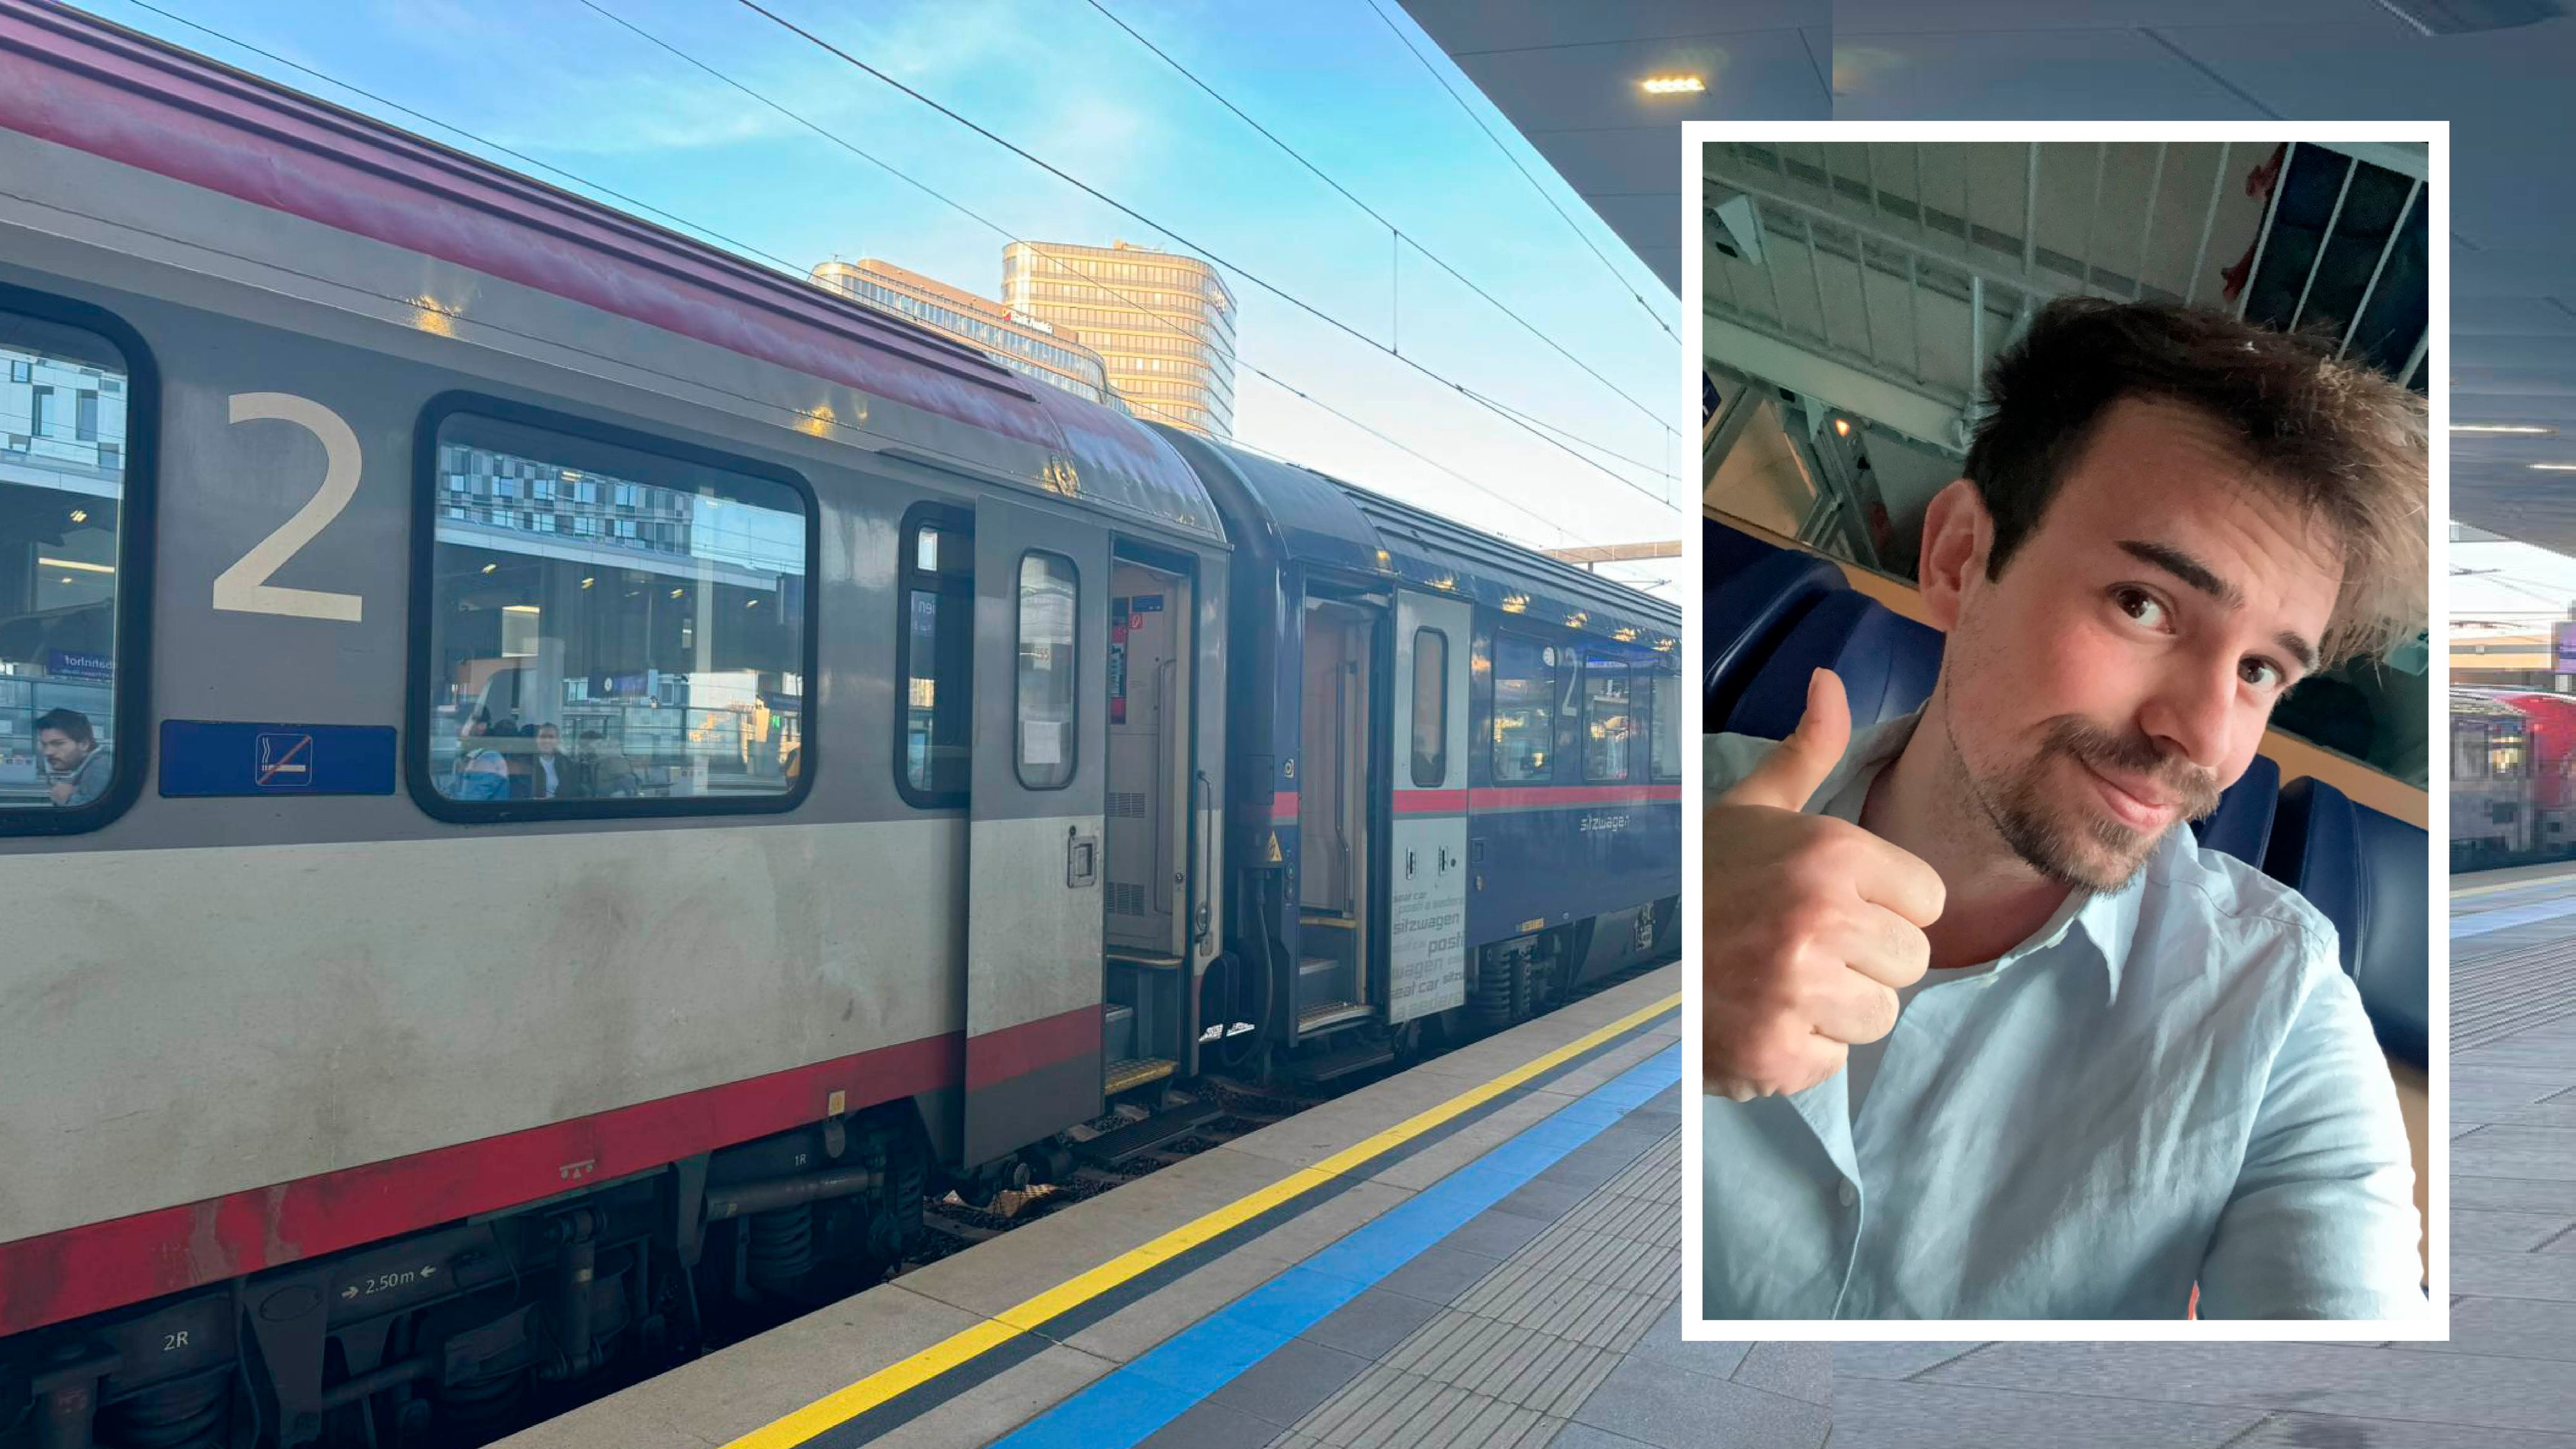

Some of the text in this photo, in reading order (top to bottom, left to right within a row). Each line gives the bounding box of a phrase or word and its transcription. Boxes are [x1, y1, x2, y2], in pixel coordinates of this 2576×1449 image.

[213, 392, 363, 622] 2
[1562, 646, 1577, 716] 2
[1393, 913, 1460, 934] sitzwagen
[1418, 980, 1439, 993] car
[164, 1331, 189, 1350] 2R
